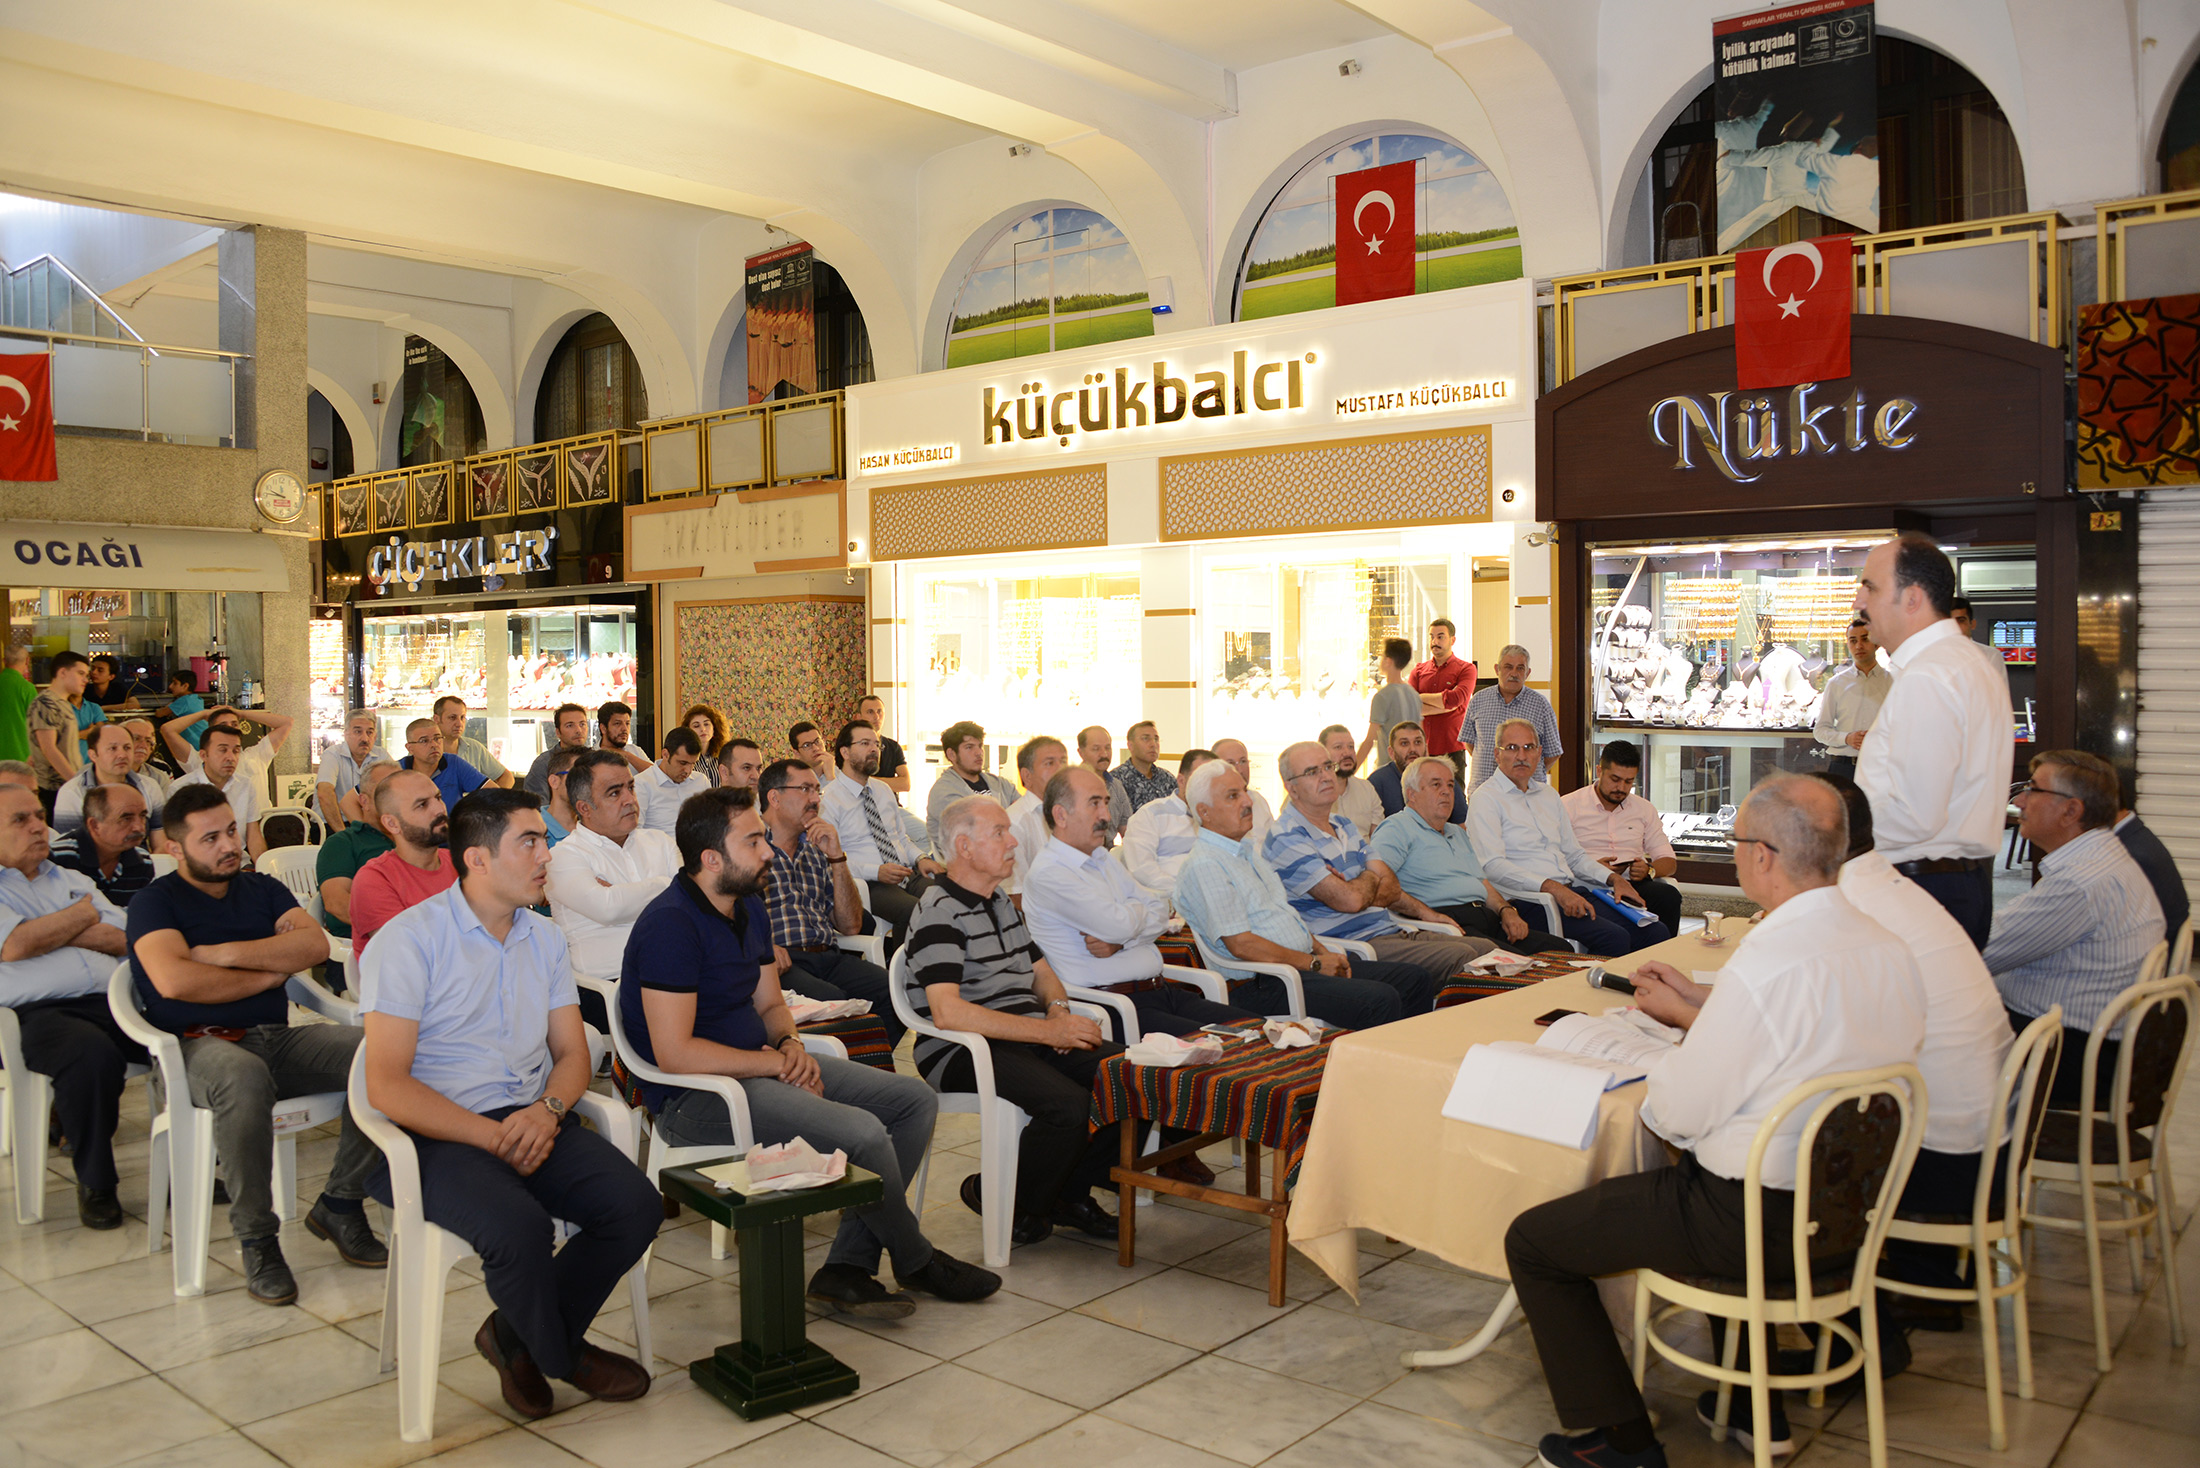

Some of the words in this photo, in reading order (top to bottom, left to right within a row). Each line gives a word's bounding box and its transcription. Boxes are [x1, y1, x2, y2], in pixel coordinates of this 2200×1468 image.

[1742, 15, 1775, 28] SARRAFLAR
[1775, 10, 1799, 20] YERALTI
[1824, 0, 1845, 9] KONYA
[1722, 40, 1747, 61] İyilik
[1749, 33, 1796, 53] arayanda
[1722, 58, 1759, 78] kötülük
[1760, 51, 1796, 71] kalmaz
[983, 350, 1305, 447] küçükbalcı
[1336, 392, 1405, 415] MUSTAFA
[1410, 381, 1507, 407] KÜÇÜKBALCI
[1648, 383, 1919, 483] Nükte
[860, 454, 890, 470] HASAN
[893, 446, 953, 465] KÜÇÜKBALCI
[2021, 481, 2036, 494] 13
[14, 537, 143, 568] OCAĞI
[366, 530, 553, 596] ÇİÇEKLER
[604, 564, 613, 579] 9
